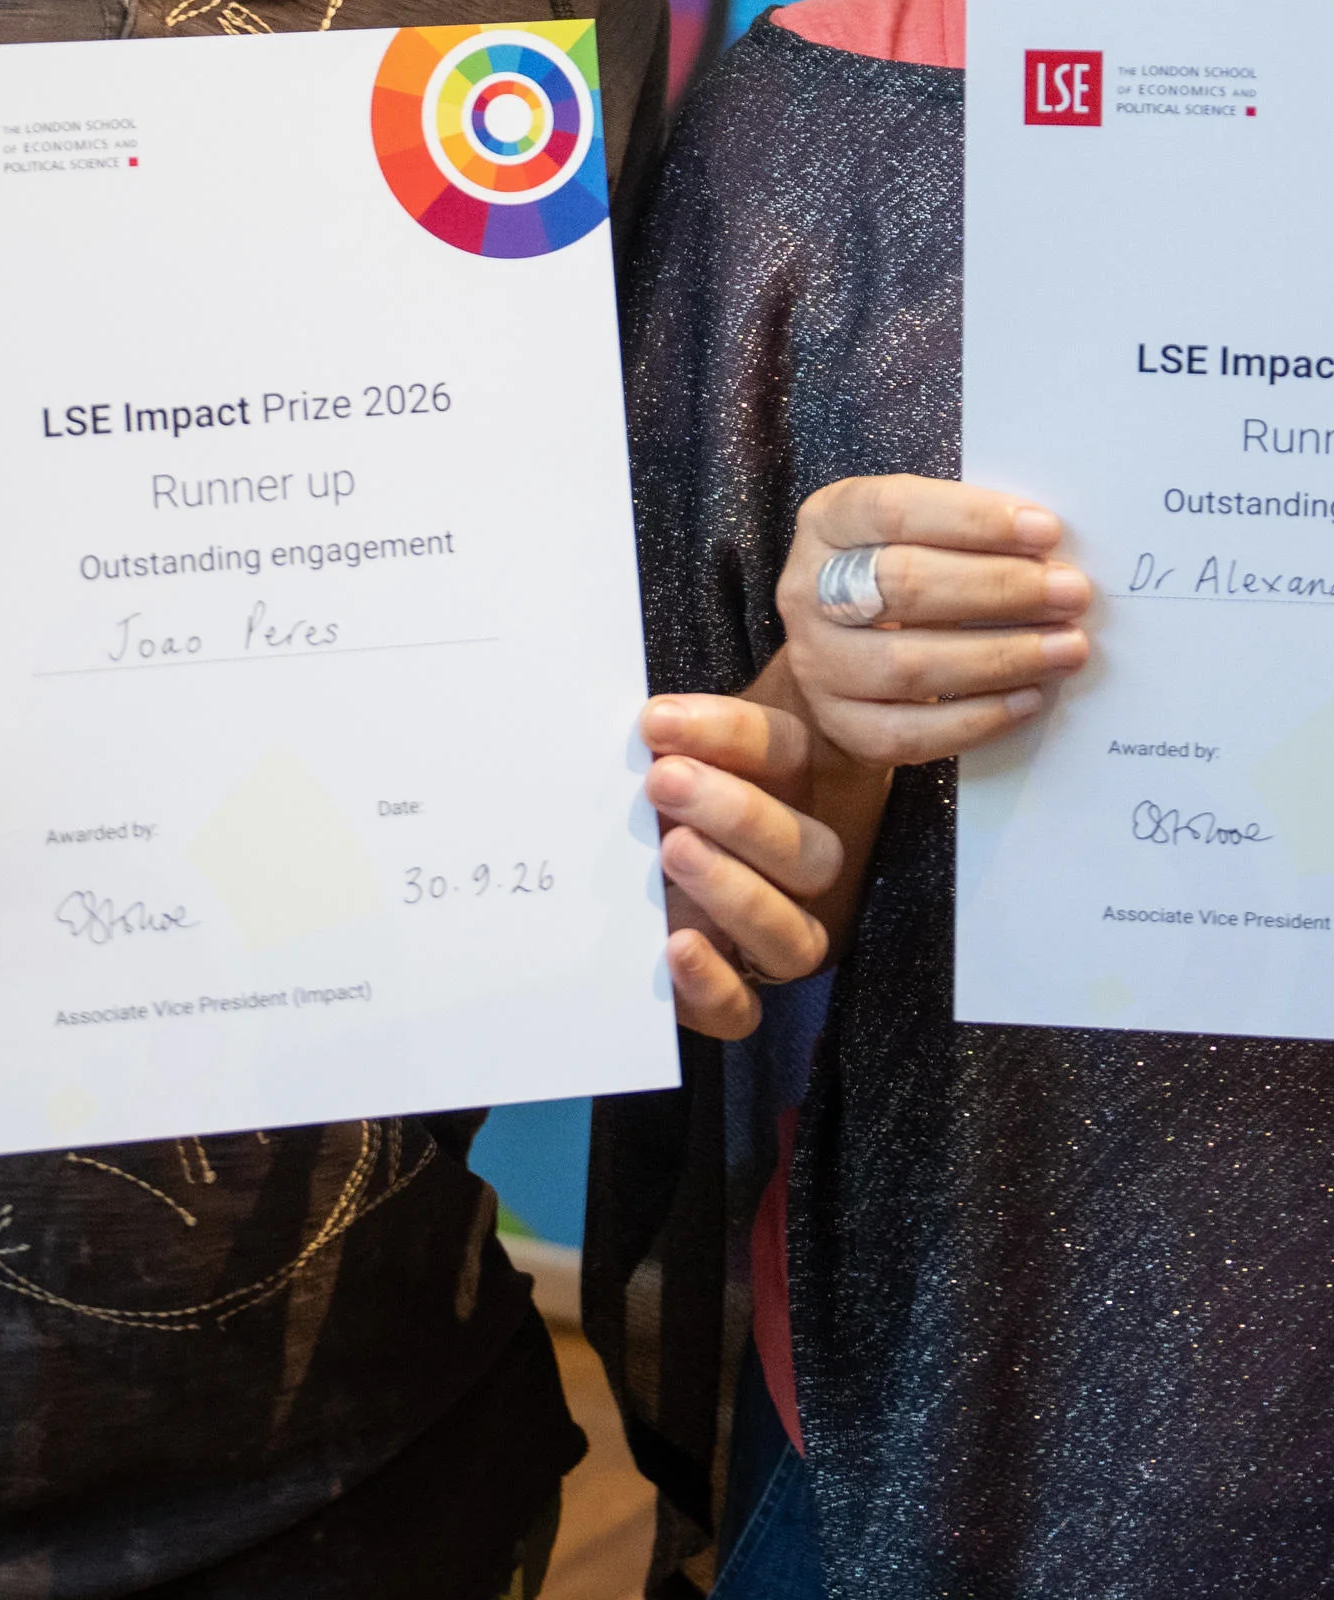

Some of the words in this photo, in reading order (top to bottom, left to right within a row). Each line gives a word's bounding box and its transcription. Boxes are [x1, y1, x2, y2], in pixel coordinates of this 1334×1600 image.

[1141, 64, 1199, 78] LONDON
[1204, 66, 1257, 79] SCHOOL
[1036, 61, 1090, 113] LSE
[1139, 84, 1226, 97] ECONOMICS
[1232, 88, 1257, 98] AND
[1117, 102, 1180, 115] POLITICAL
[1185, 103, 1236, 116] SCIENCE
[26, 120, 82, 134] LONDON
[86, 118, 138, 132] SCHOOL
[24, 139, 108, 153] ECONOMICS
[114, 139, 138, 149] AND
[3, 159, 66, 173] POLITICAL
[70, 156, 120, 170] SCIENCE
[1138, 343, 1209, 376] LSE
[43, 404, 113, 438] LSE
[124, 397, 251, 438] Impact
[263, 392, 352, 423] Prize
[363, 382, 452, 418] 2026
[151, 472, 294, 510] Runner
[307, 468, 356, 506] up
[79, 545, 262, 581] Outstanding
[271, 530, 456, 570] engagement
[1128, 552, 1176, 592] Dr
[108, 612, 203, 661] Joao
[244, 600, 339, 650] Peres
[1107, 740, 1190, 758] Awarded
[1194, 742, 1220, 762] by:
[377, 799, 424, 817] Date:
[45, 824, 128, 845] Awarded
[1102, 905, 1194, 925] Associate
[1198, 909, 1239, 927] Vice
[1244, 911, 1331, 931] President
[54, 1006, 149, 1027] Associate
[152, 1000, 195, 1018] Vice
[198, 990, 288, 1014] President
[292, 980, 372, 1007] (Impact)
